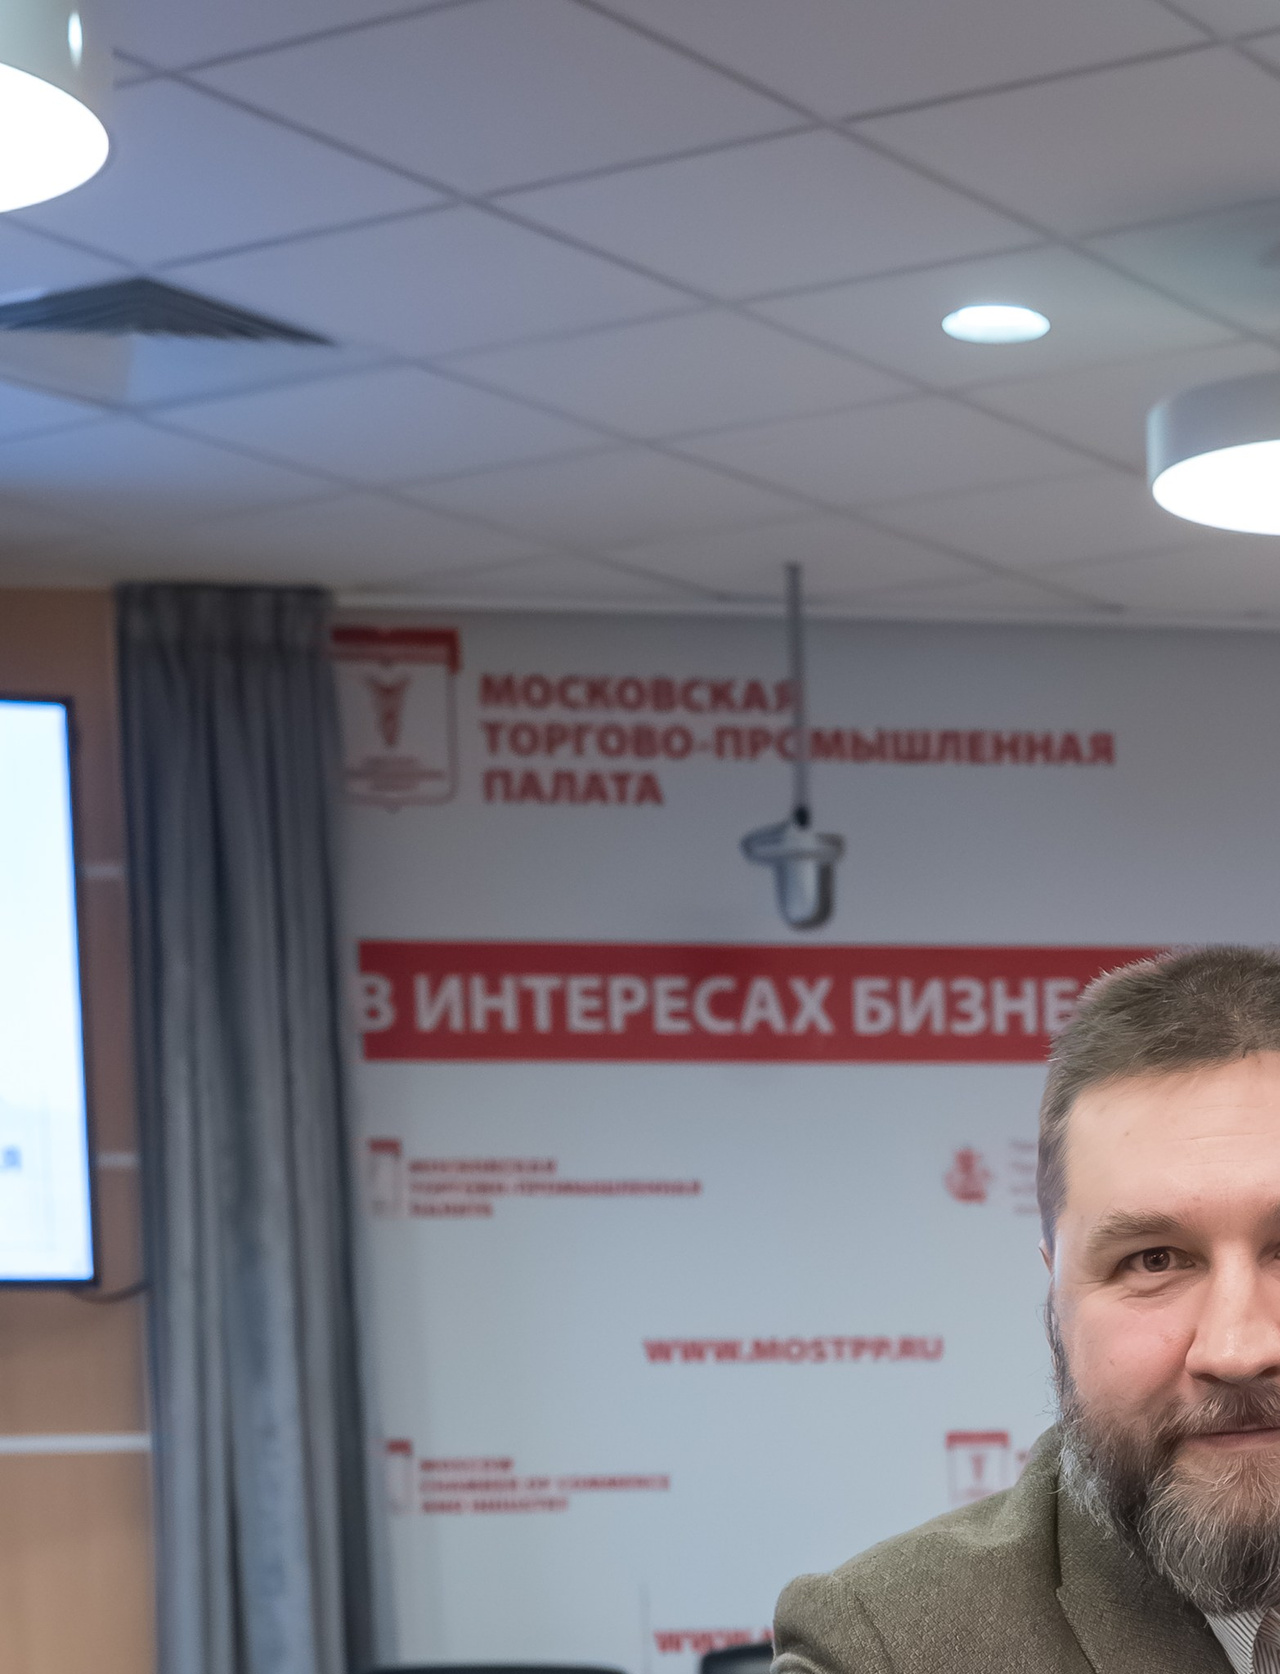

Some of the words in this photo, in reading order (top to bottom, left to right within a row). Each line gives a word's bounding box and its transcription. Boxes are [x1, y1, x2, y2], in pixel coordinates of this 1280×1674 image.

[480, 673, 803, 713] МОСКОВСКАЯ
[481, 720, 1117, 766] ТОРГОВО-ПРОМЫШЛЕННАЯ
[483, 768, 665, 806] ПАЛАТА
[354, 972, 397, 1035] В
[413, 973, 834, 1036] ИНТЕРЕСАХ
[852, 976, 1082, 1036] БИЗНЕ
[643, 1337, 944, 1363] WWW.MOSTPP.RU
